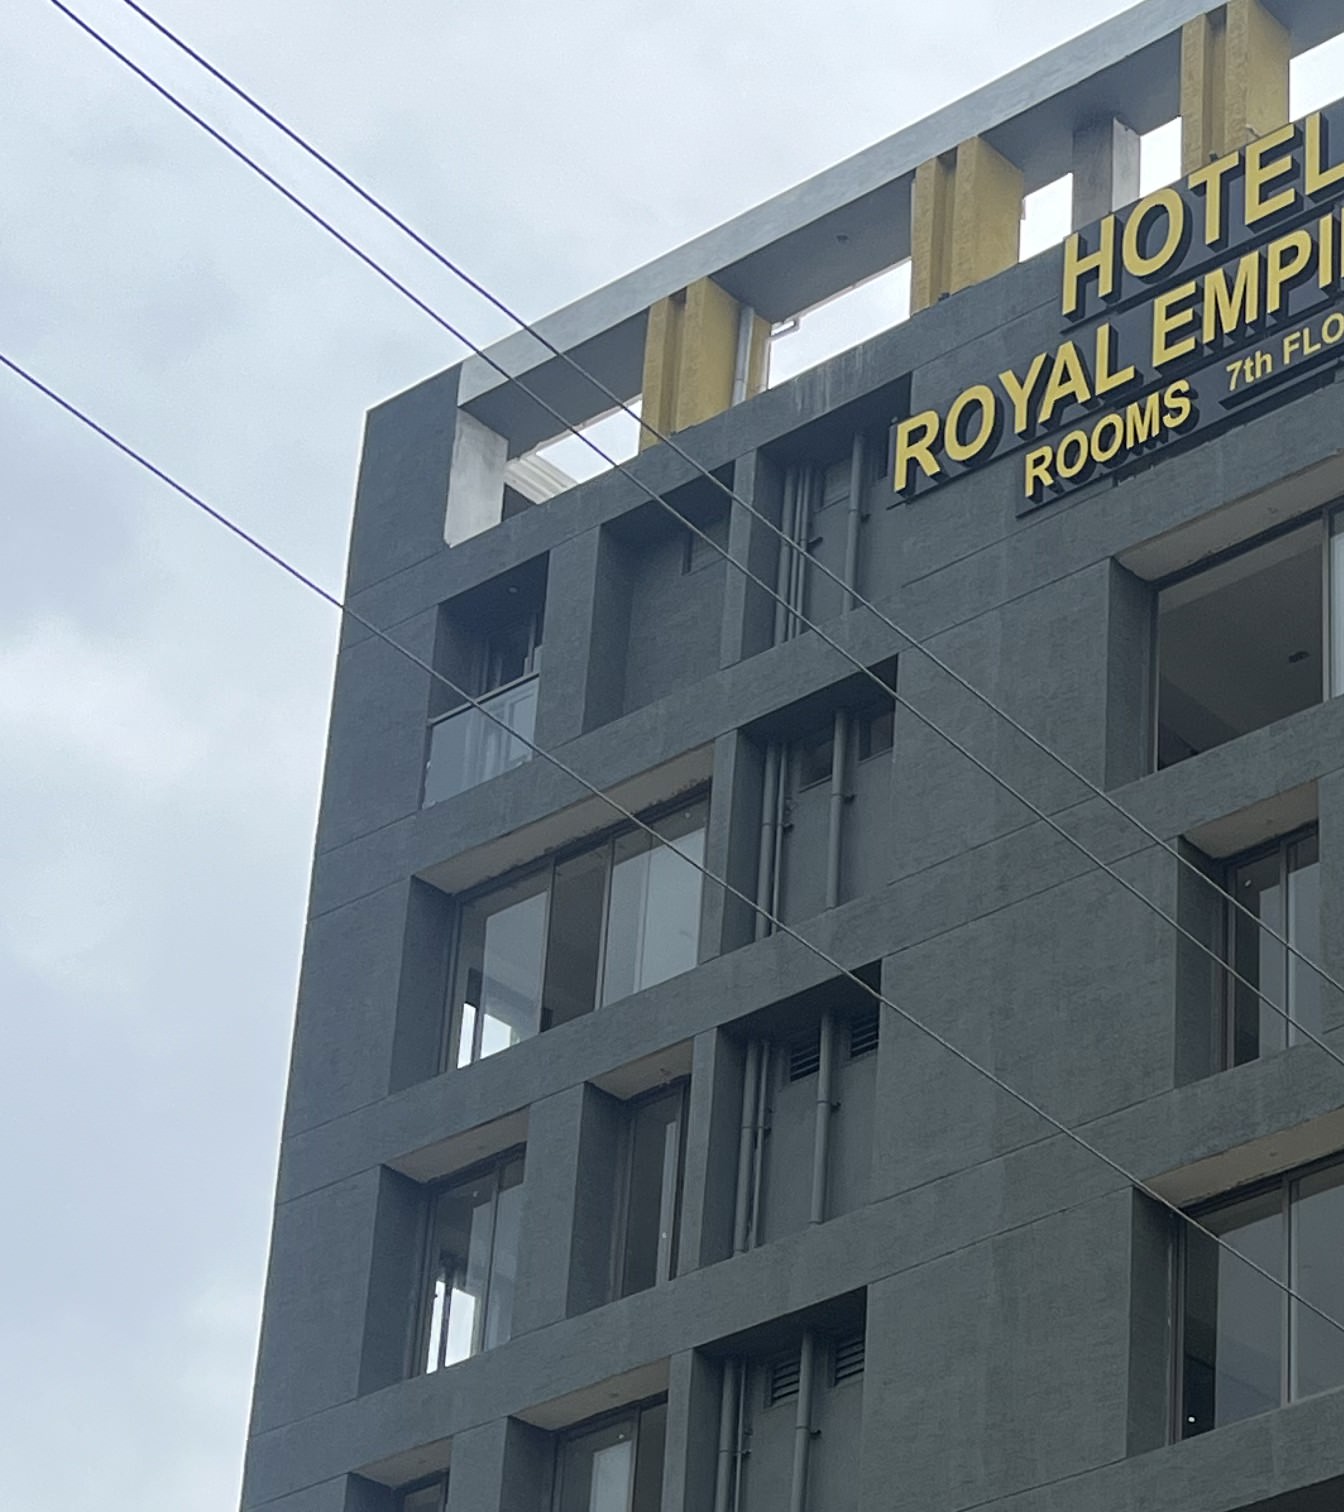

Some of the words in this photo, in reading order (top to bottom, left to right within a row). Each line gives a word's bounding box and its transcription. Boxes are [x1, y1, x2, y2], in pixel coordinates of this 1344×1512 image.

[893, 323, 1136, 493] ROYAL
[1024, 379, 1192, 498] ROOMS
[1226, 345, 1274, 392] 7th
